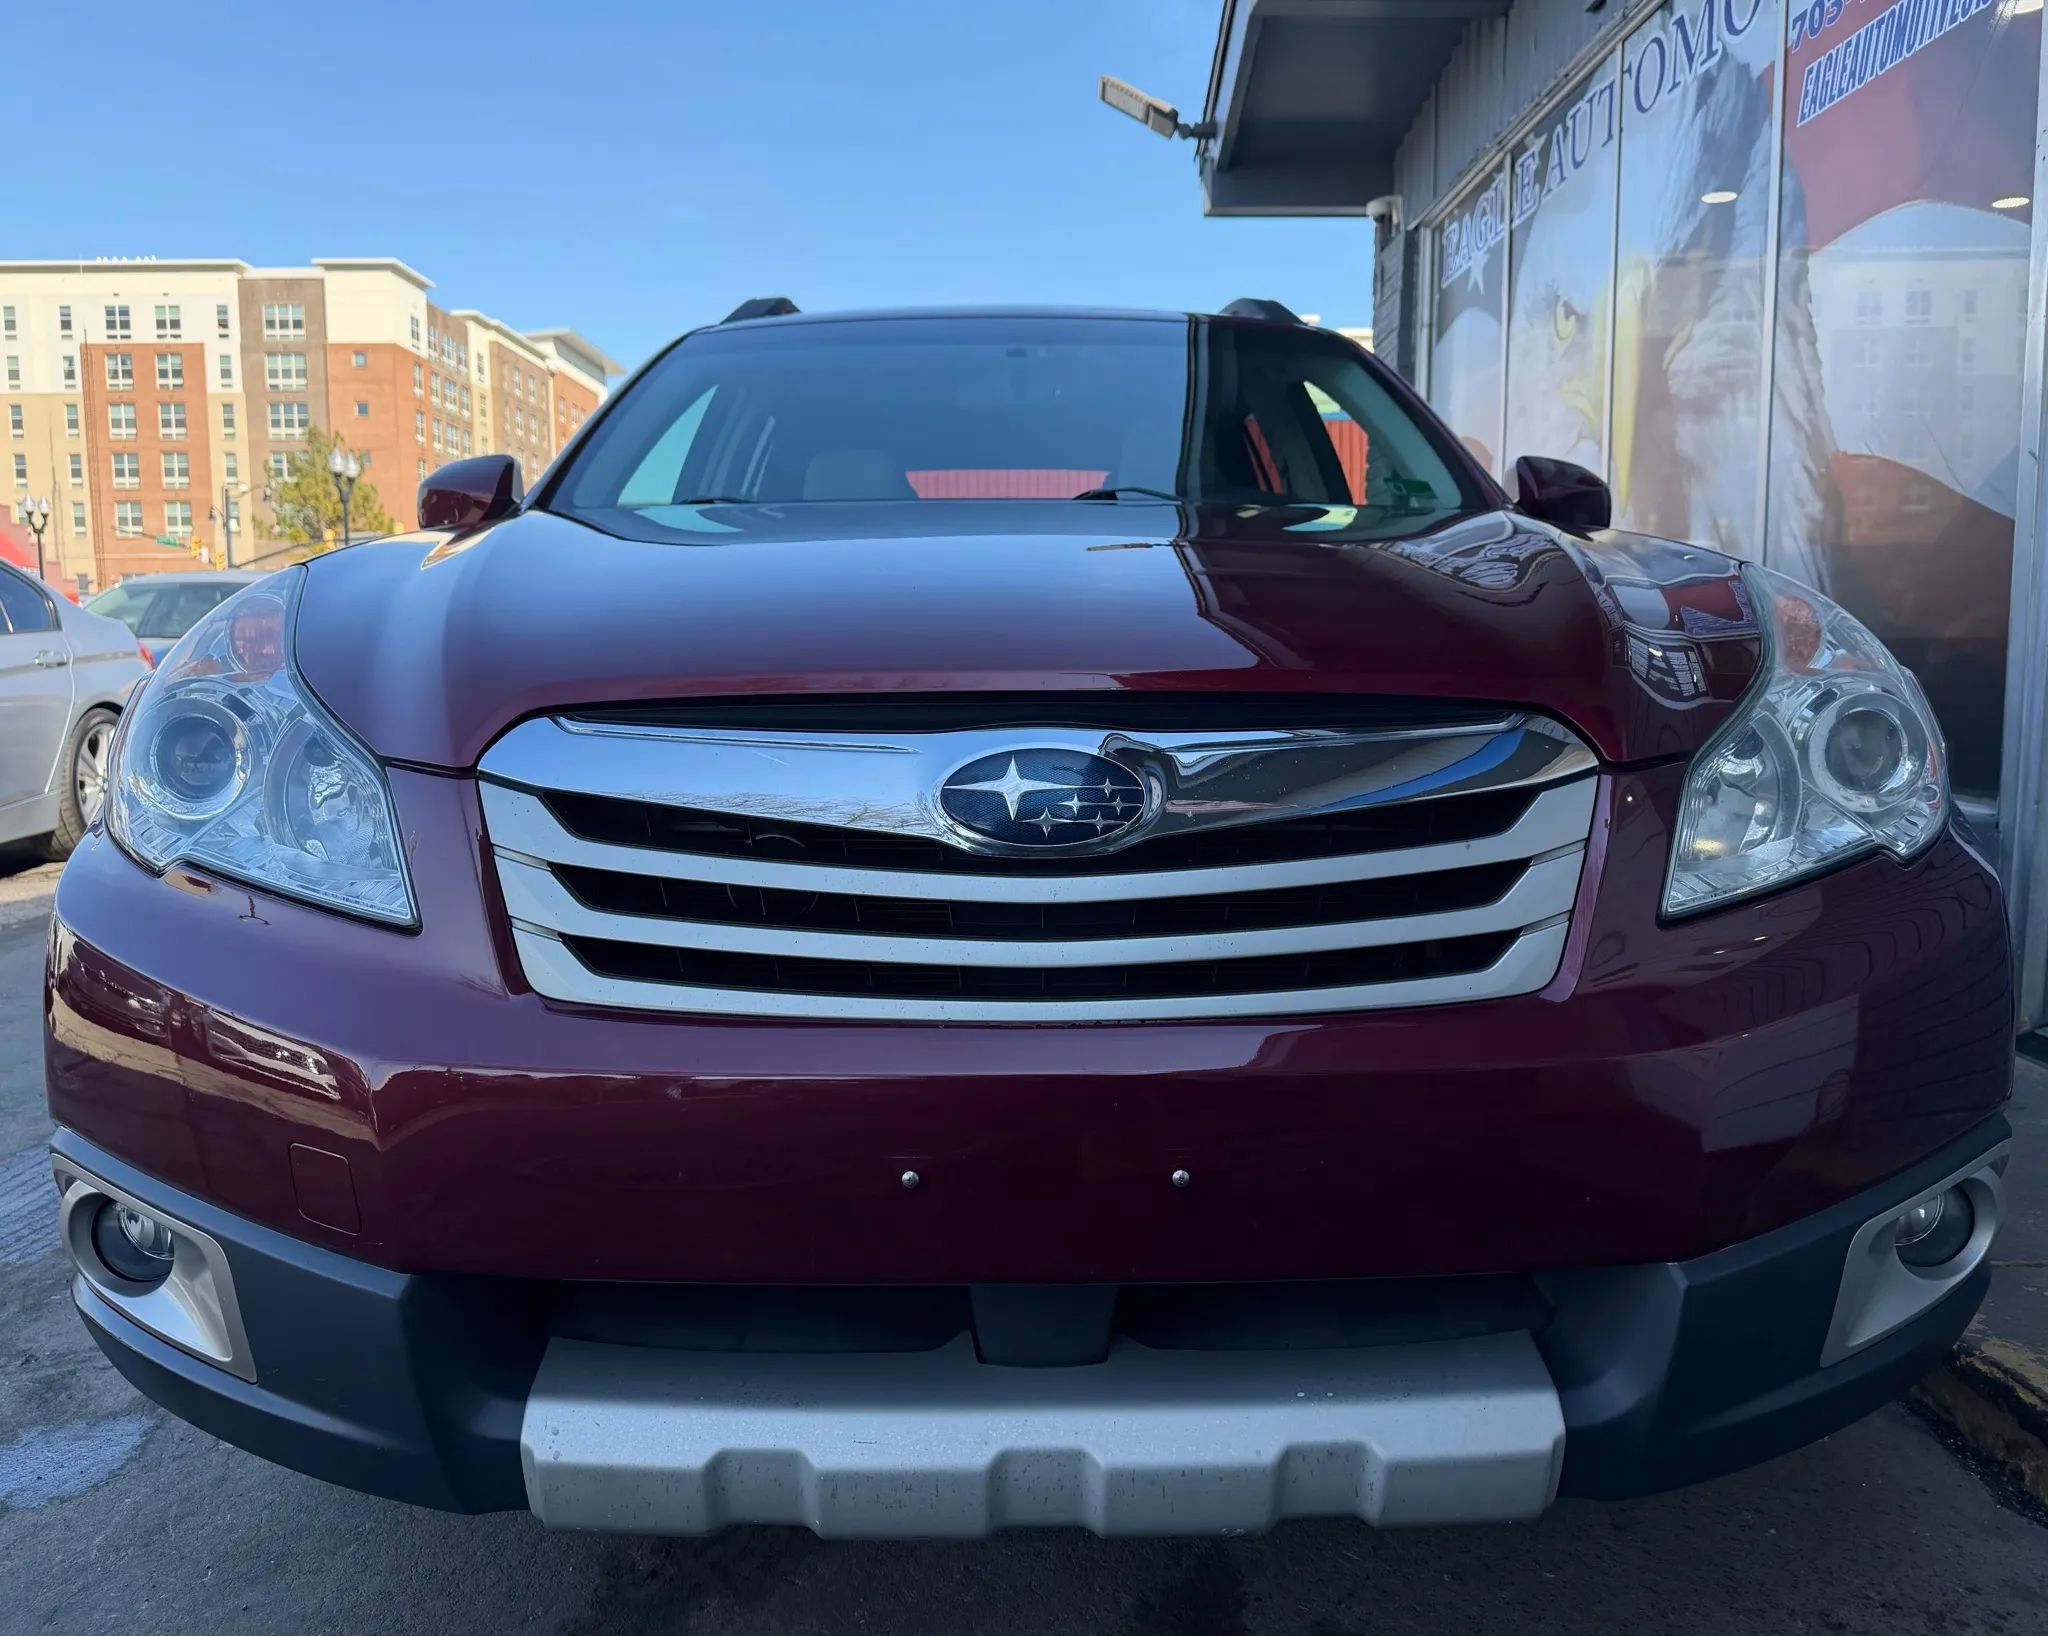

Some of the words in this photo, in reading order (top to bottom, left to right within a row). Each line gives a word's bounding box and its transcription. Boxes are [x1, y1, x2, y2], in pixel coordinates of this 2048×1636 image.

[1791, 0, 1864, 53] 703
[1797, 0, 1993, 127] EAGLEAUTOMOTIV
[1442, 150, 1541, 287] EAGLE
